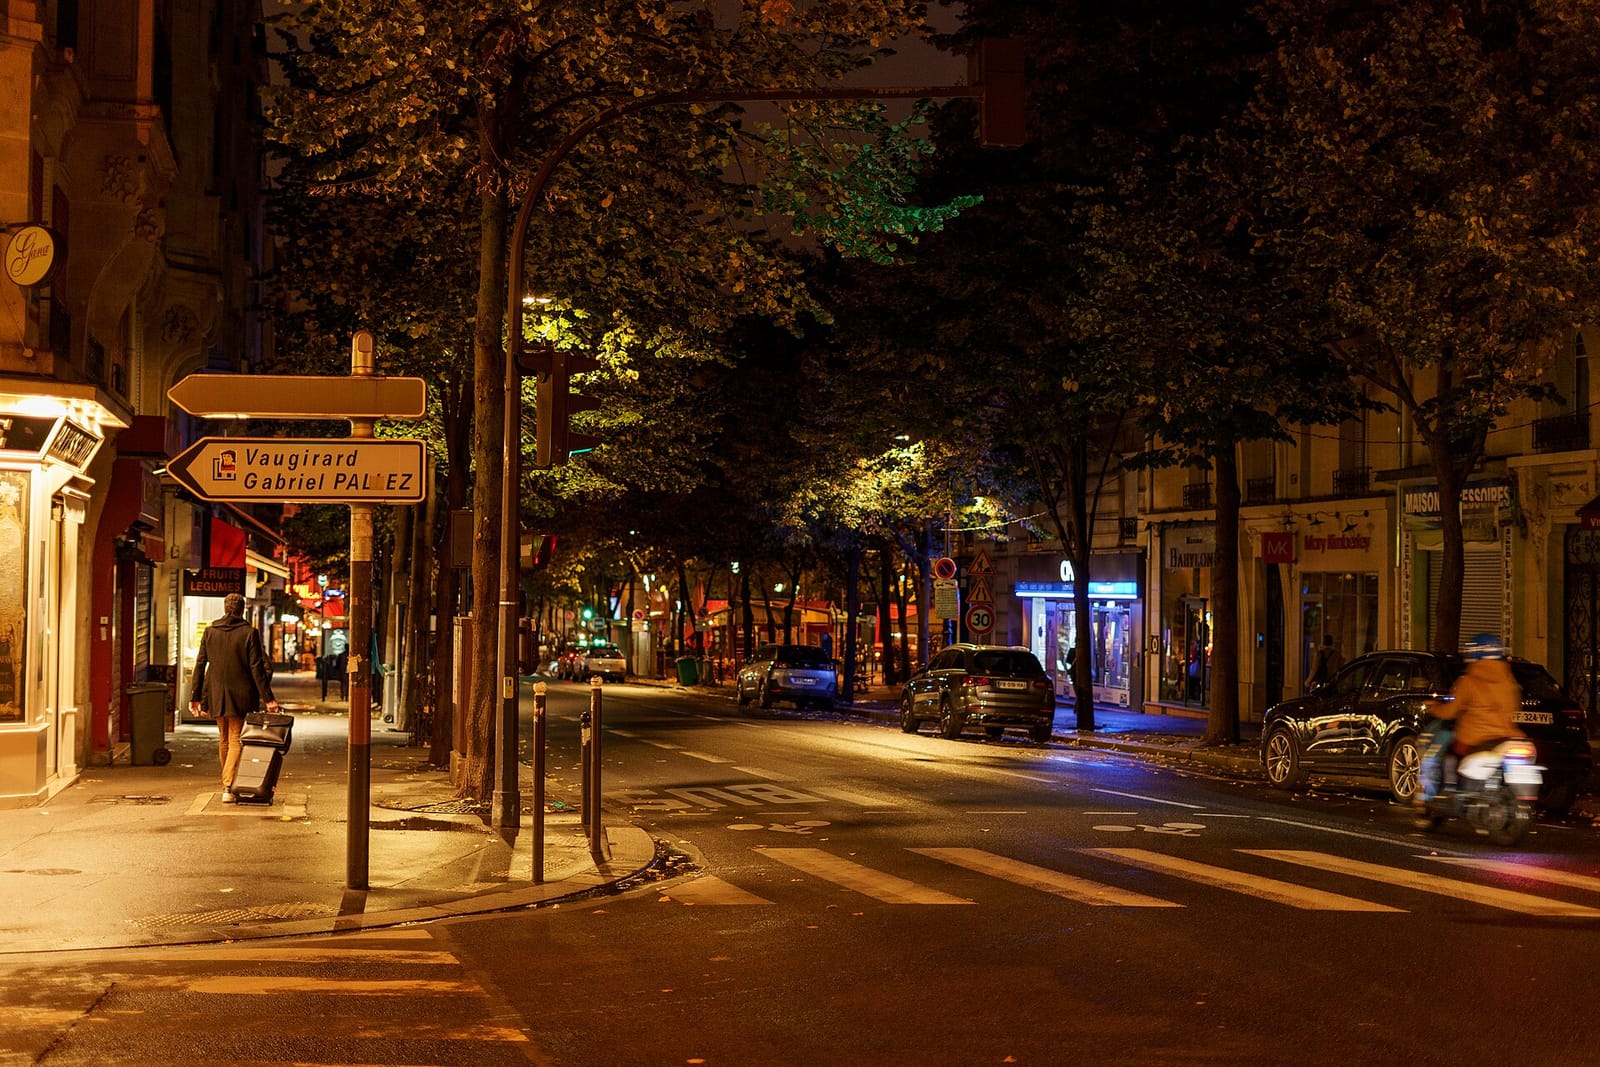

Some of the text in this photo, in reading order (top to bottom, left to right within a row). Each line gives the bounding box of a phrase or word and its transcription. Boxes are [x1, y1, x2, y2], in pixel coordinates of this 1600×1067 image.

[246, 449, 358, 471] Vaugirard
[244, 473, 413, 490] Gabriel PALEZ
[1405, 490, 1440, 513] MAISON
[1267, 540, 1289, 555] MK
[1170, 547, 1217, 568] BABYLON
[202, 569, 241, 580] FRUITS
[190, 581, 241, 592] LEGUMES
[972, 613, 990, 627] 30
[602, 784, 829, 809] BUS
